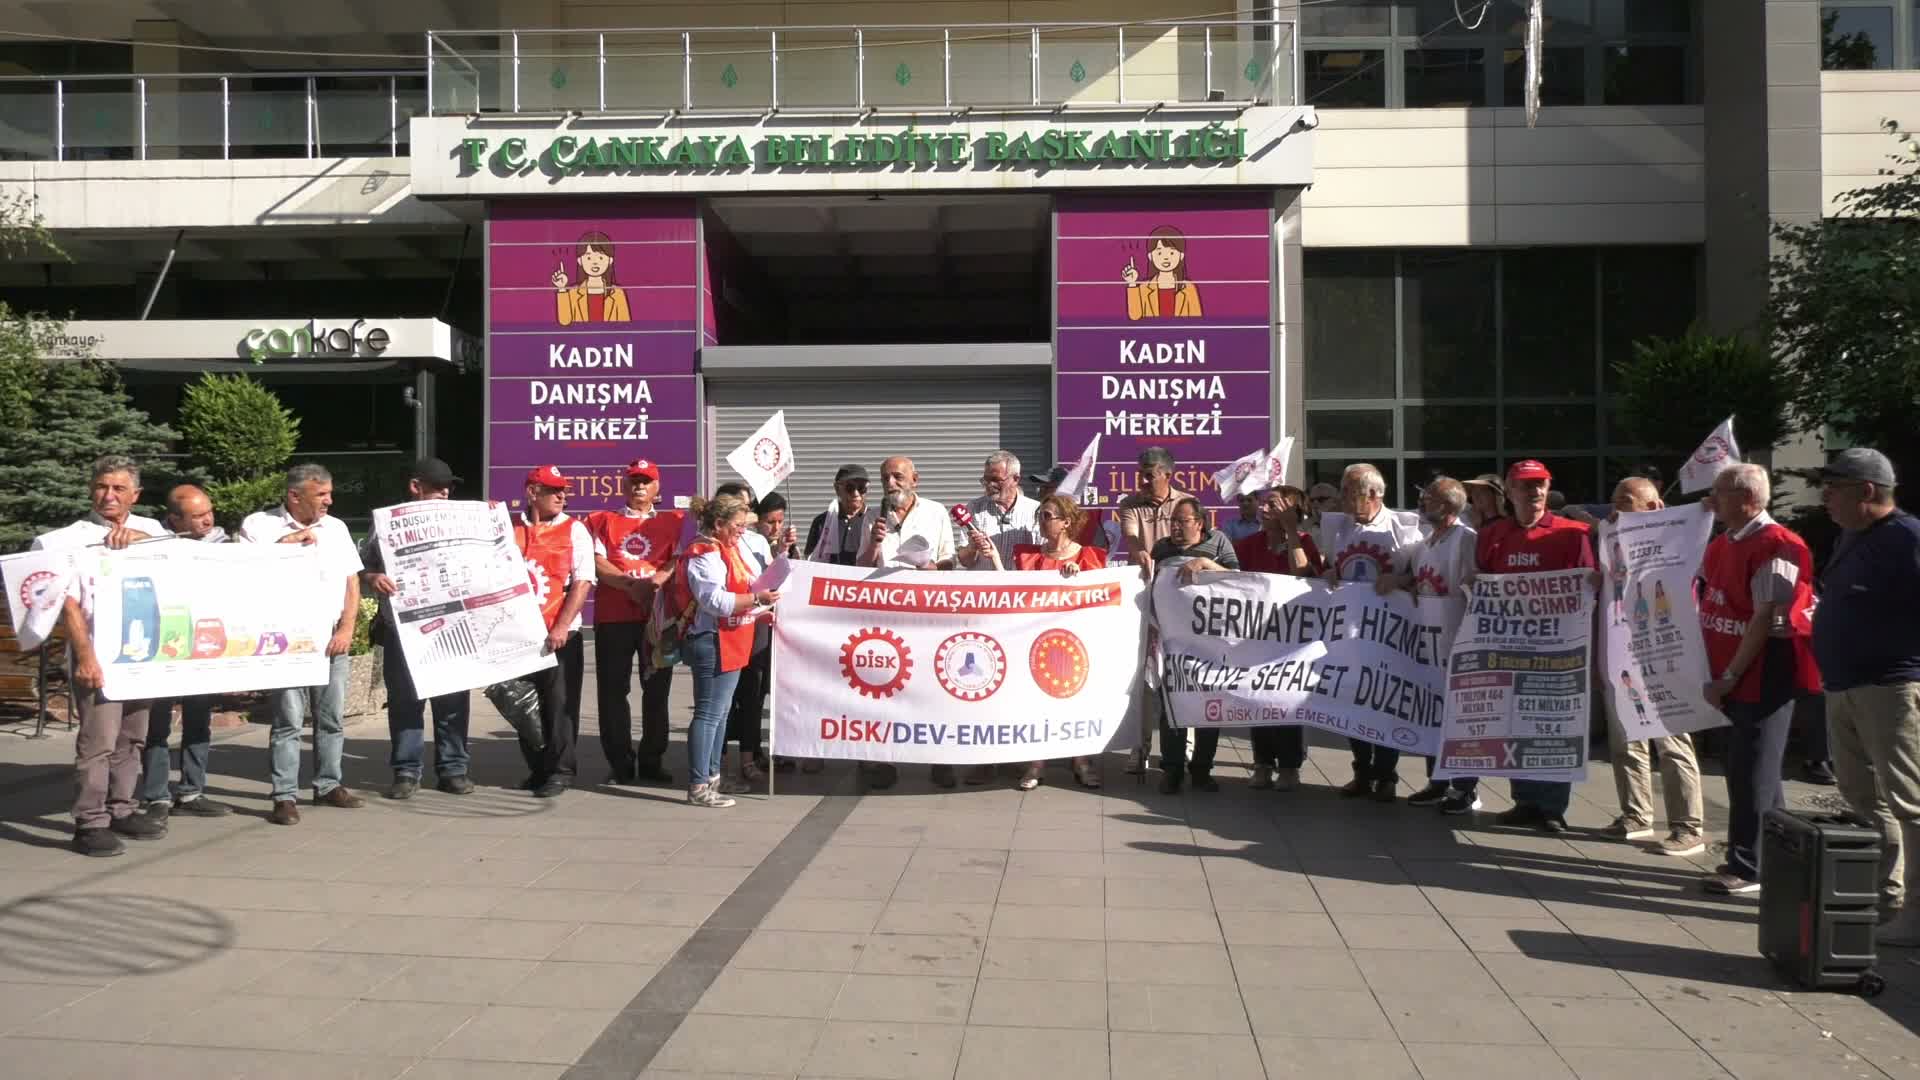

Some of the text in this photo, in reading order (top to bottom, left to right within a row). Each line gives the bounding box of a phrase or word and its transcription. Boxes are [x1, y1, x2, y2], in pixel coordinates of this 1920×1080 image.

[550, 135, 750, 176] ÇANKAYA
[766, 126, 970, 165] BELEDİYE
[985, 122, 1248, 167] BAŞKANLIĞI
[550, 344, 633, 368] KADIN
[1120, 340, 1205, 363] KADIN
[531, 380, 653, 411] DANIŞMA
[1102, 375, 1226, 406] DANIŞMA
[534, 408, 648, 440] MERKEZİ
[1106, 403, 1222, 435] MERKEZİ
[1508, 552, 1541, 566] DİSK
[823, 580, 1111, 612] İNSANCA YAŞAMAK HAKTIR!
[1503, 574, 1584, 597] CÖMERT
[1191, 594, 1347, 644] SERMAYEYE
[1469, 599, 1525, 617] ALKA
[1477, 615, 1561, 638] BÜTÇE!
[855, 650, 897, 669] DİSK
[1165, 653, 1249, 693] EMEKLİYE
[1251, 657, 1349, 698] SEFALET
[1354, 662, 1445, 728] DÜZENİD
[821, 714, 1103, 745] DİSK/DEV-EMEKLİ-SEN
